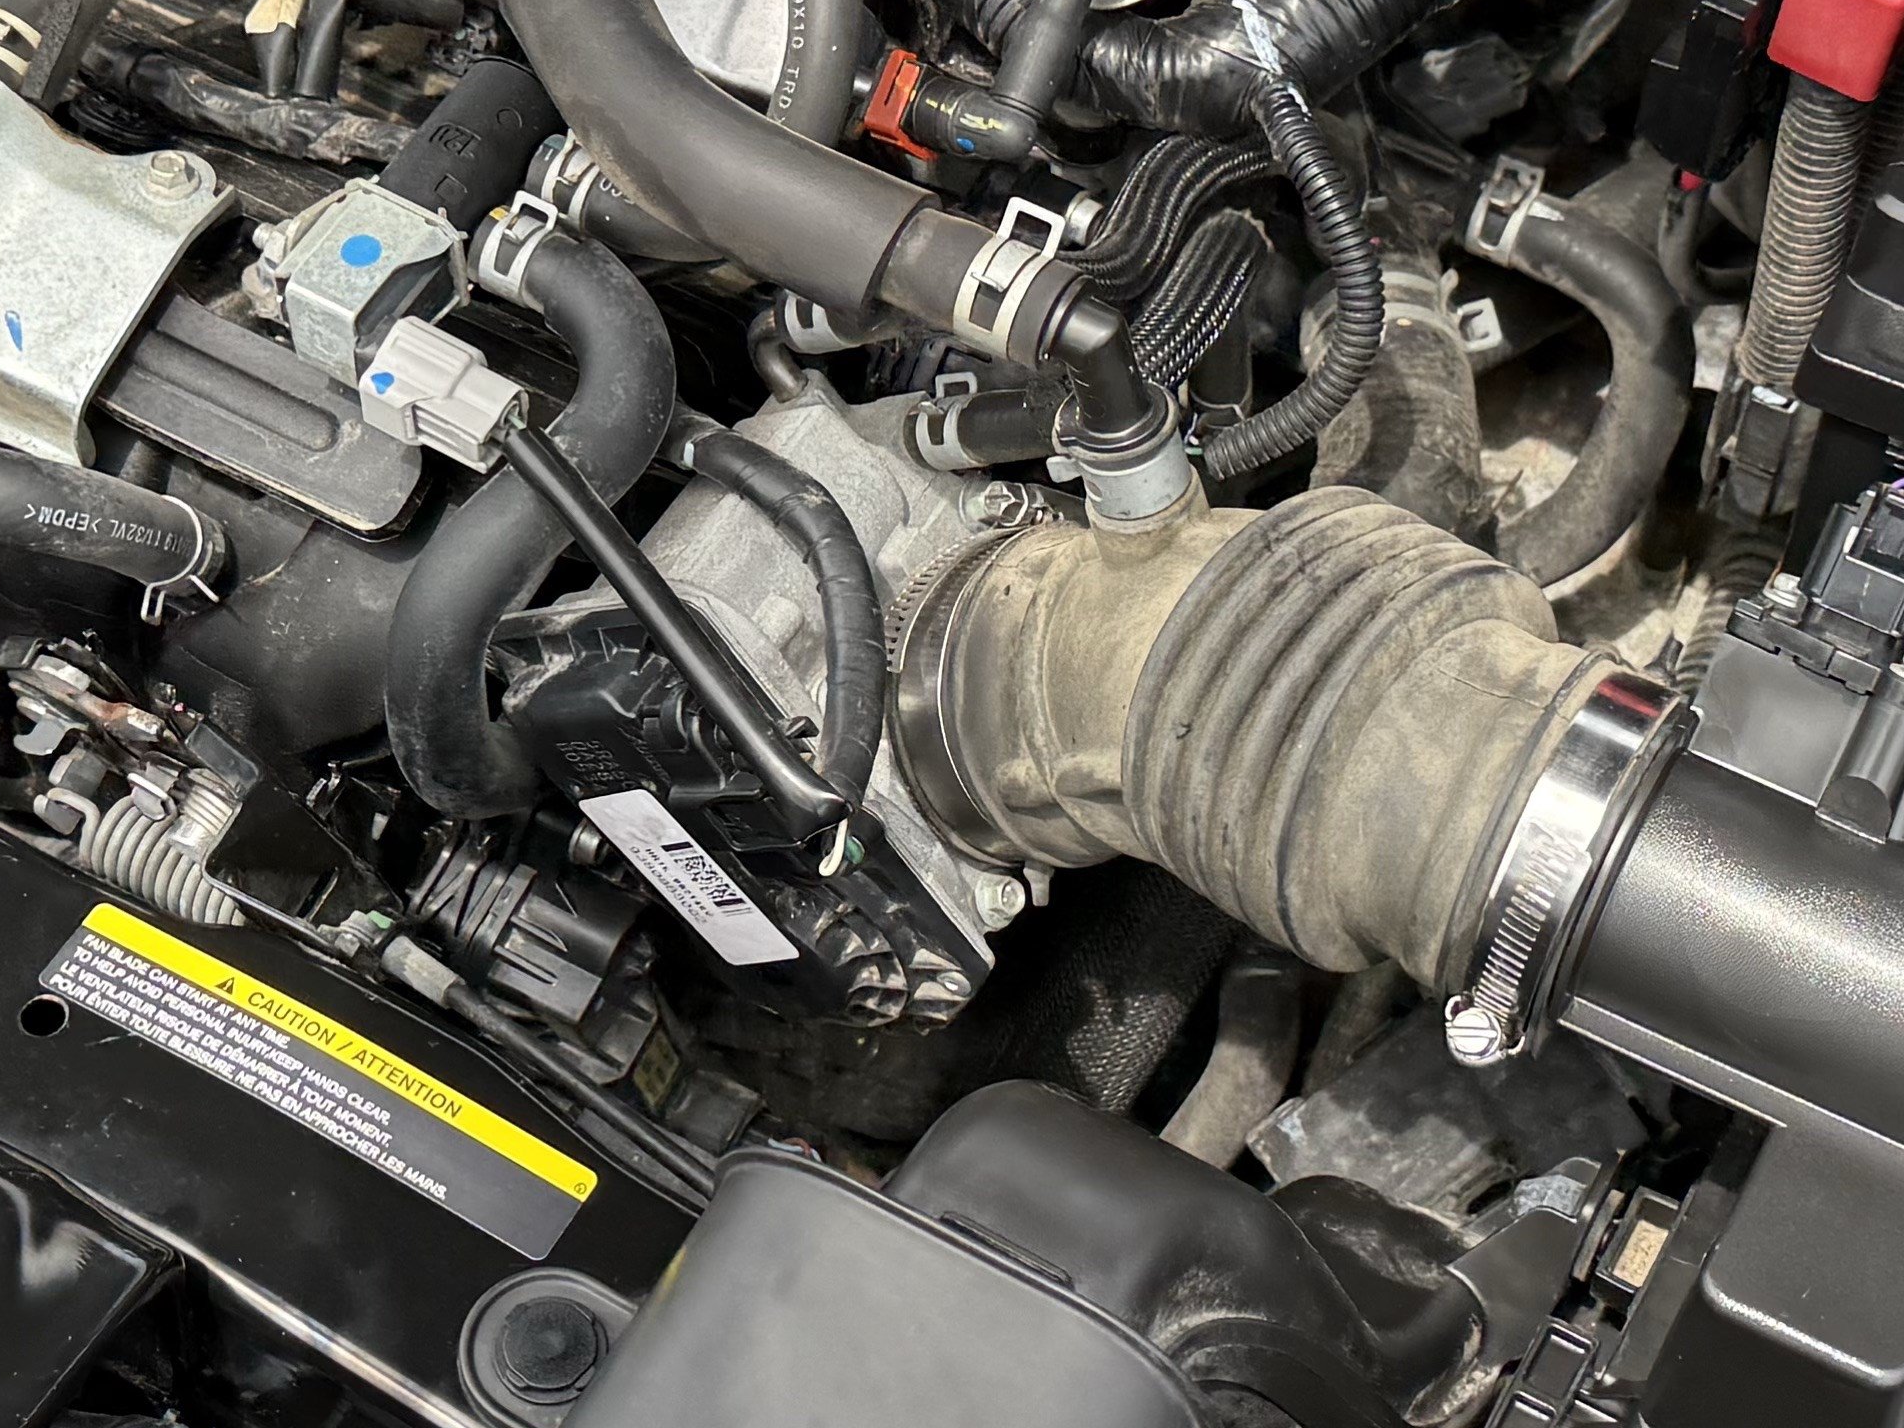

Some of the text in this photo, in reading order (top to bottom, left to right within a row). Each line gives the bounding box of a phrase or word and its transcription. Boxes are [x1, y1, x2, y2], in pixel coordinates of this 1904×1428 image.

[23, 502, 102, 533] >EPDM<
[59, 959, 393, 1147] LE VENTILATEUR RISQUE DE DÉMARRER À TOUT MOMENT.
[71, 945, 392, 1126] TO HELP AVOID PERSONAL HANDS CLEAR.
[81, 931, 291, 1049] FAN BLADE CAN START AT ANY TIME.
[245, 987, 463, 1119] CAUTION / ATTENTION
[48, 971, 89, 1002] POUR
[85, 988, 132, 1024] ÉVITER
[128, 1012, 169, 1044] TOUTE
[234, 1068, 257, 1089] NE
[253, 1078, 283, 1103] PAS
[279, 1093, 302, 1114] EN
[297, 1105, 379, 1159] APPROCHER
[375, 1150, 405, 1175] LES
[401, 1166, 448, 1200] MAINS.
